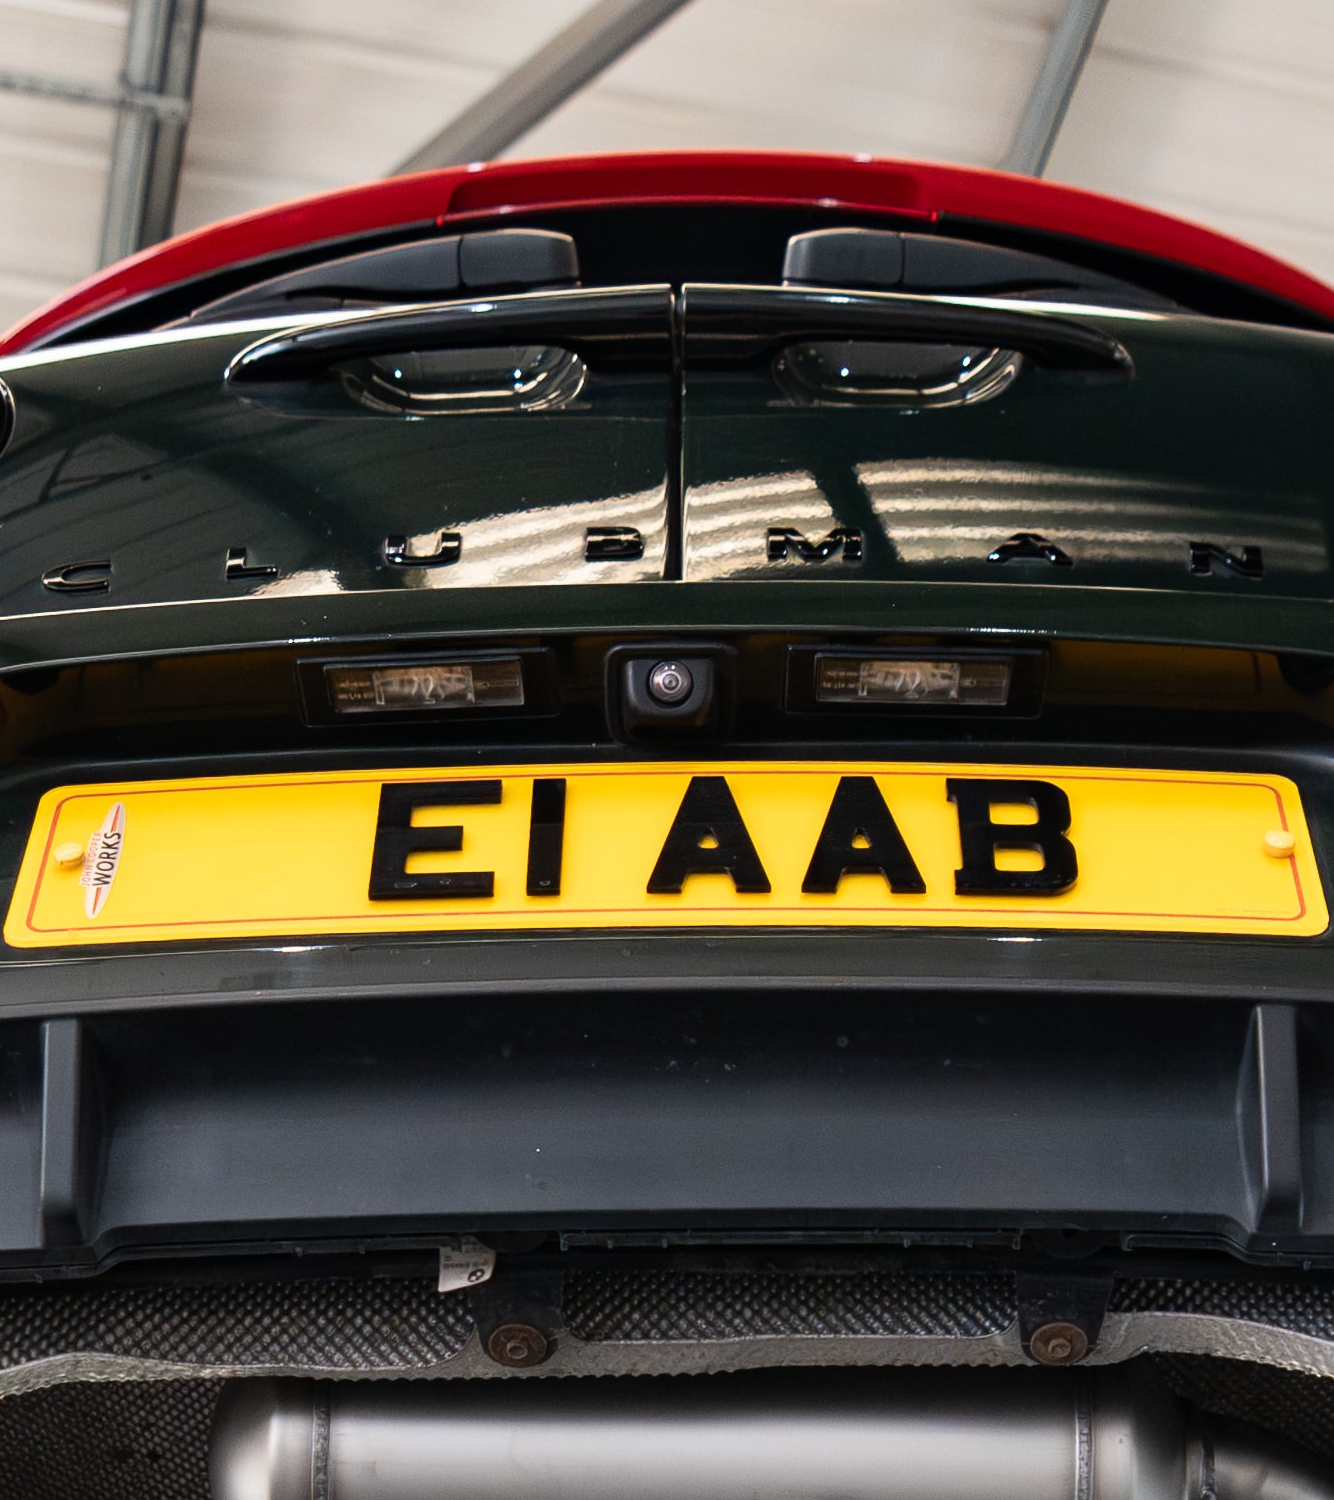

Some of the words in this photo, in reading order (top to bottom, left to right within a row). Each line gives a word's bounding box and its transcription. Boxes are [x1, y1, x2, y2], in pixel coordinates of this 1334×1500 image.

[41, 525, 1265, 594] CLUBMAN
[92, 832, 122, 886] WORKS
[646, 775, 1077, 897] AAB
